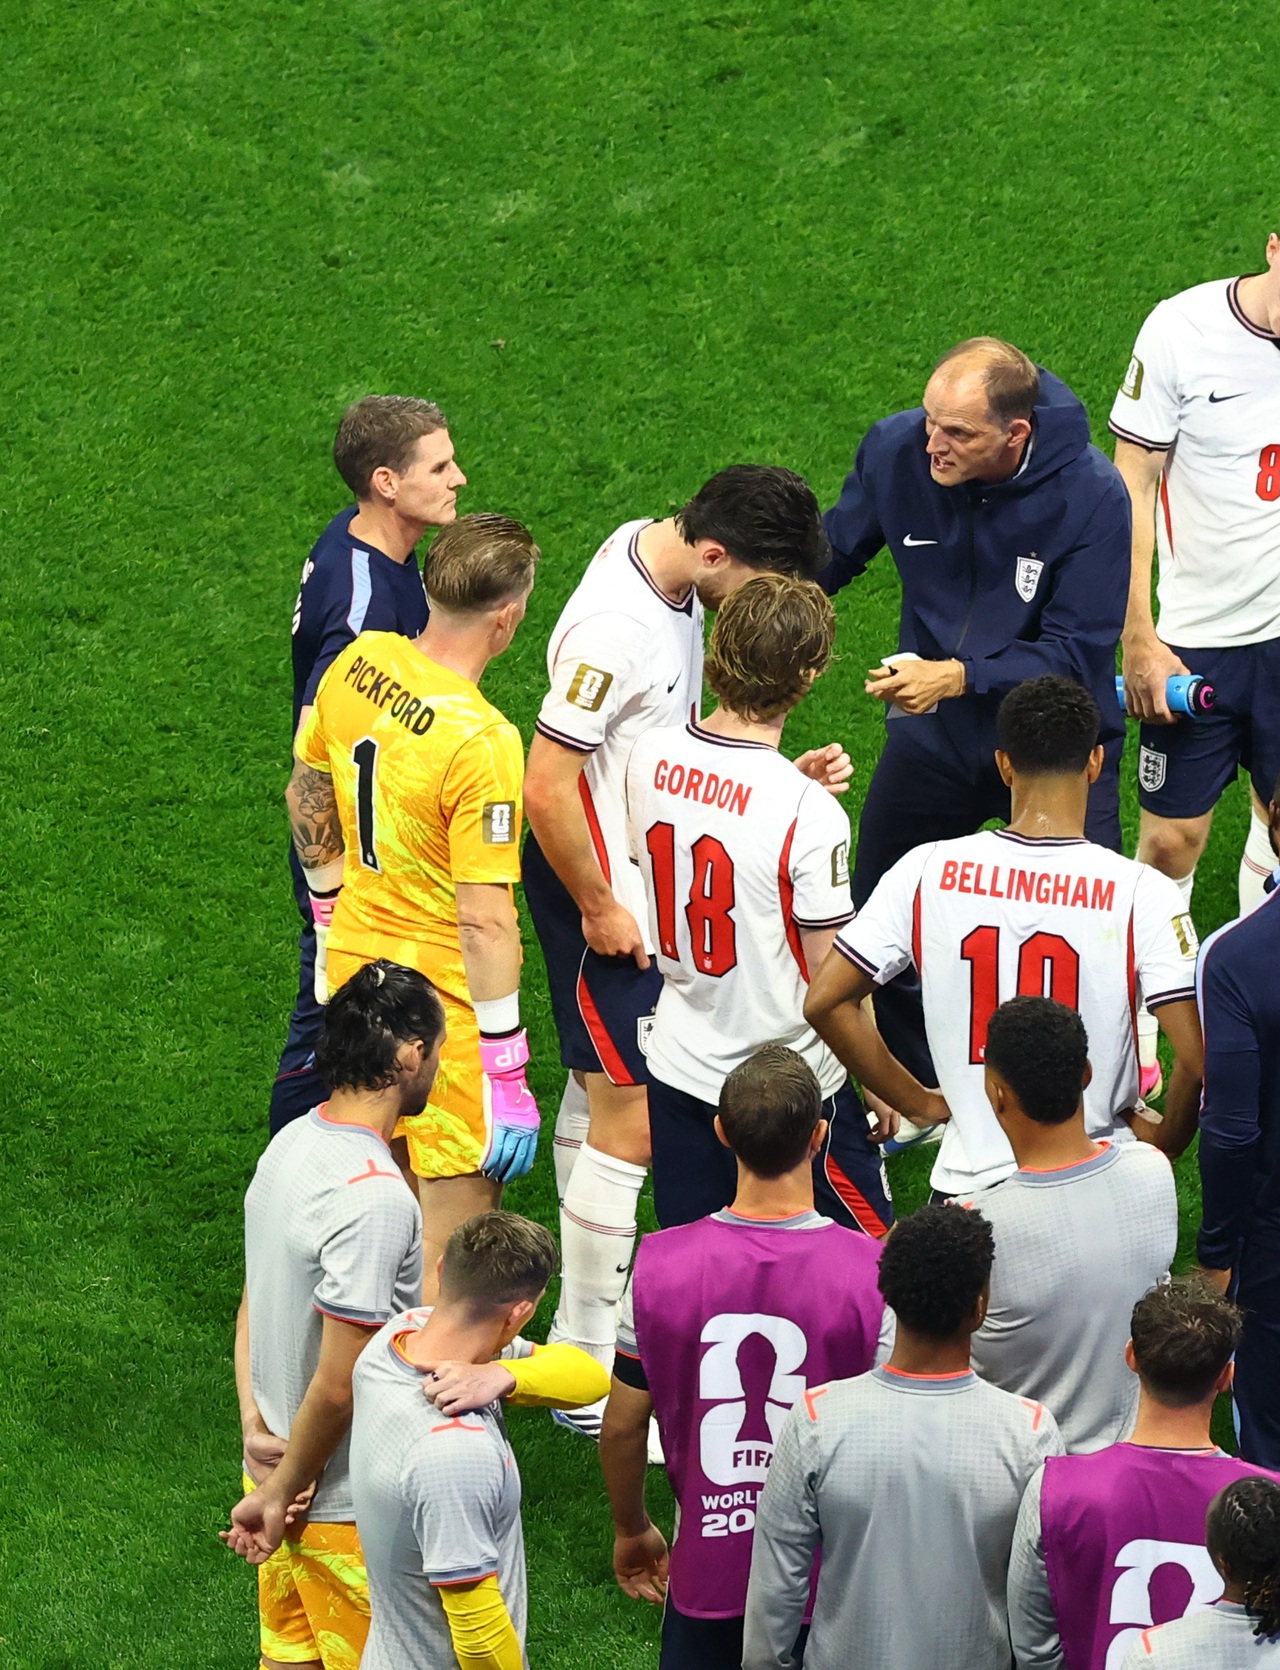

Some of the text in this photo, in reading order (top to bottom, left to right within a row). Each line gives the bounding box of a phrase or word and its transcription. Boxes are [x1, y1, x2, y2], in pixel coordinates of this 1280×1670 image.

[344, 655, 435, 736] PICKFORD
[351, 735, 383, 874] 1
[654, 759, 752, 816] GORDON
[645, 820, 738, 978] 18
[939, 860, 1116, 911] BELLINGHAM
[960, 924, 1080, 1065] 10
[495, 1042, 524, 1067] JP
[701, 1508, 756, 1537] 20
